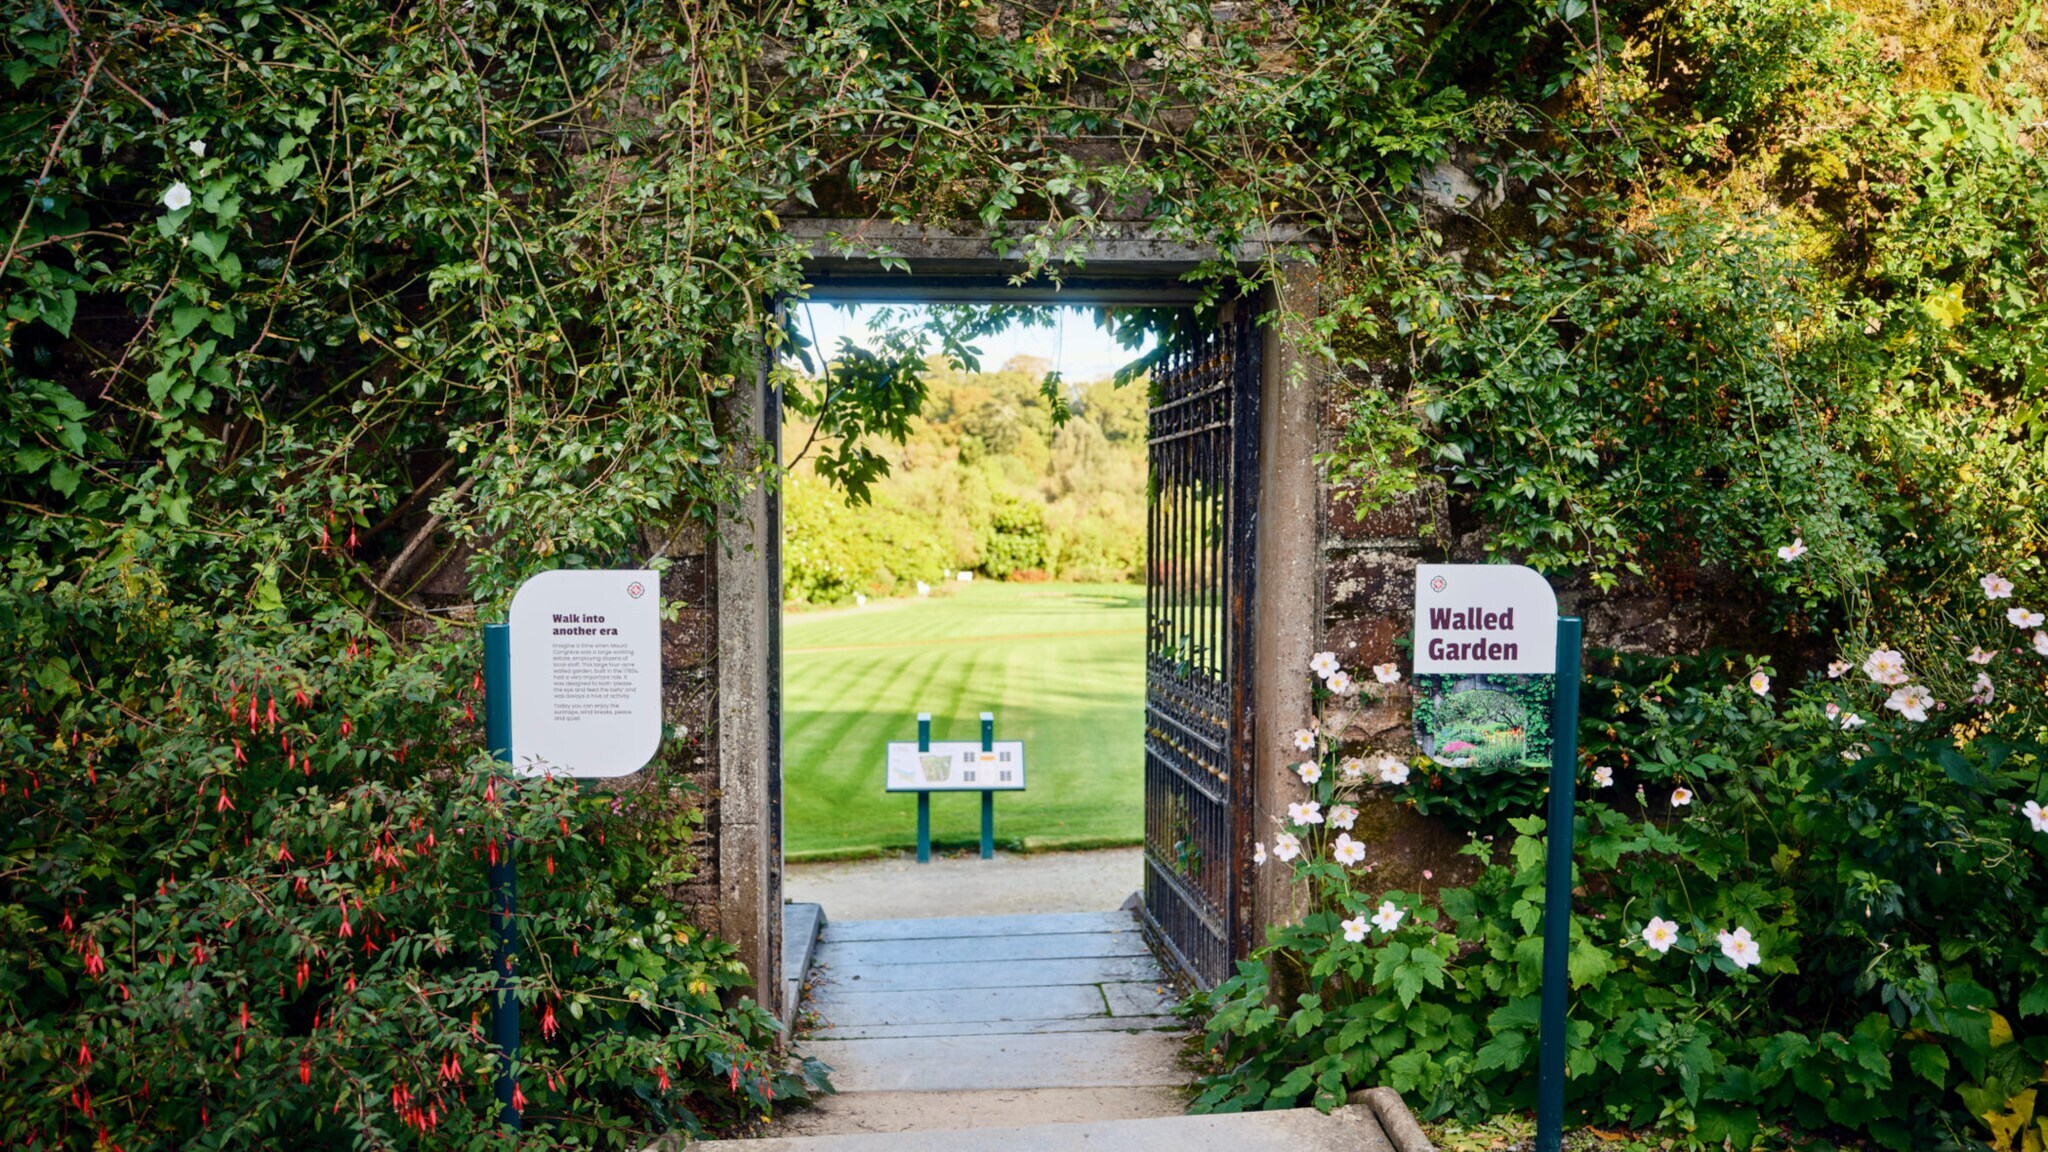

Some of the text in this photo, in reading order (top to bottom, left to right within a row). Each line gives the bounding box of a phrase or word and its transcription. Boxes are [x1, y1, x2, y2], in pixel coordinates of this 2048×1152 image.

[552, 614, 605, 624] Walk into
[1429, 607, 1514, 630] Walled
[552, 626, 618, 636] another era
[1428, 637, 1518, 661] Garden
